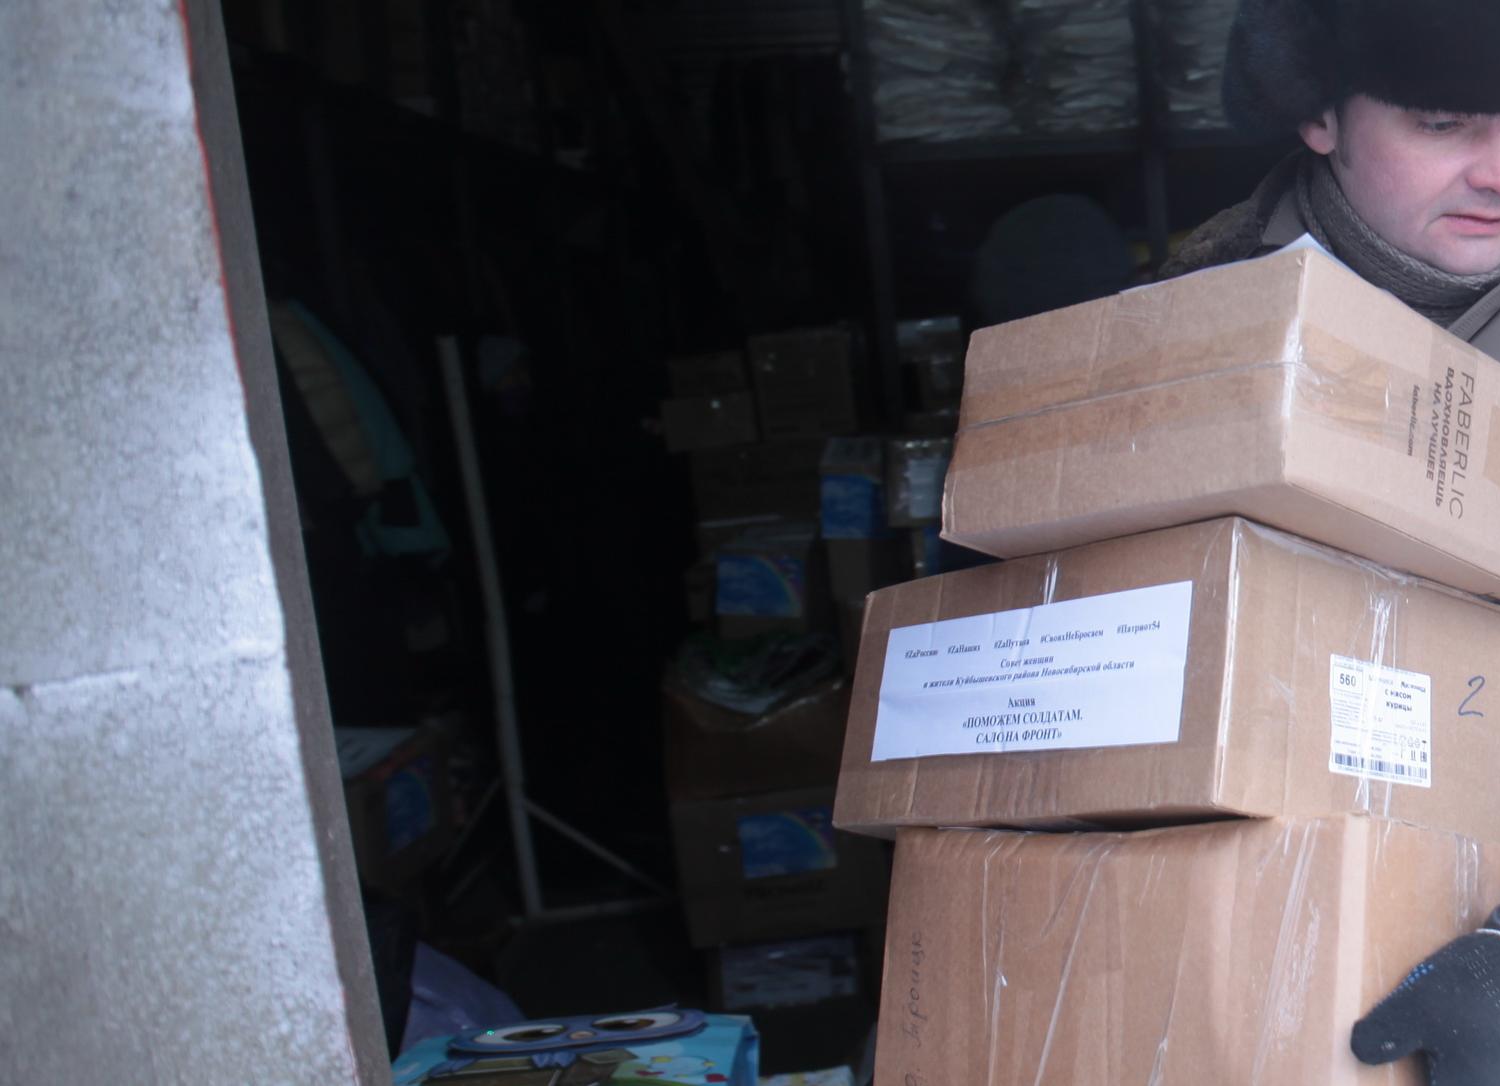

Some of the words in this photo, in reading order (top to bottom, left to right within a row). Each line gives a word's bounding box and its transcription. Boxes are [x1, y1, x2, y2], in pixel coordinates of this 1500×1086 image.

[1432, 382, 1443, 405] НА
[1407, 384, 1420, 457] faberlic.com
[1426, 409, 1440, 481] ЛУЧШЕЕ
[1434, 367, 1455, 508] ВДОХНОВЛЯЕШЬ
[1449, 370, 1475, 520] FABERLIC
[955, 673, 1012, 687] Куйбышевского
[1013, 671, 1040, 682] района
[1041, 662, 1101, 677] Новосибирской
[1102, 660, 1135, 671] области
[1000, 657, 1021, 669] Совет
[1023, 655, 1054, 666] женщин
[1007, 697, 1036, 708] Акция
[1457, 674, 1486, 717] 2
[962, 713, 1021, 728] «ПОМОЖЕМ
[1021, 727, 1063, 741] ФРОНТ»
